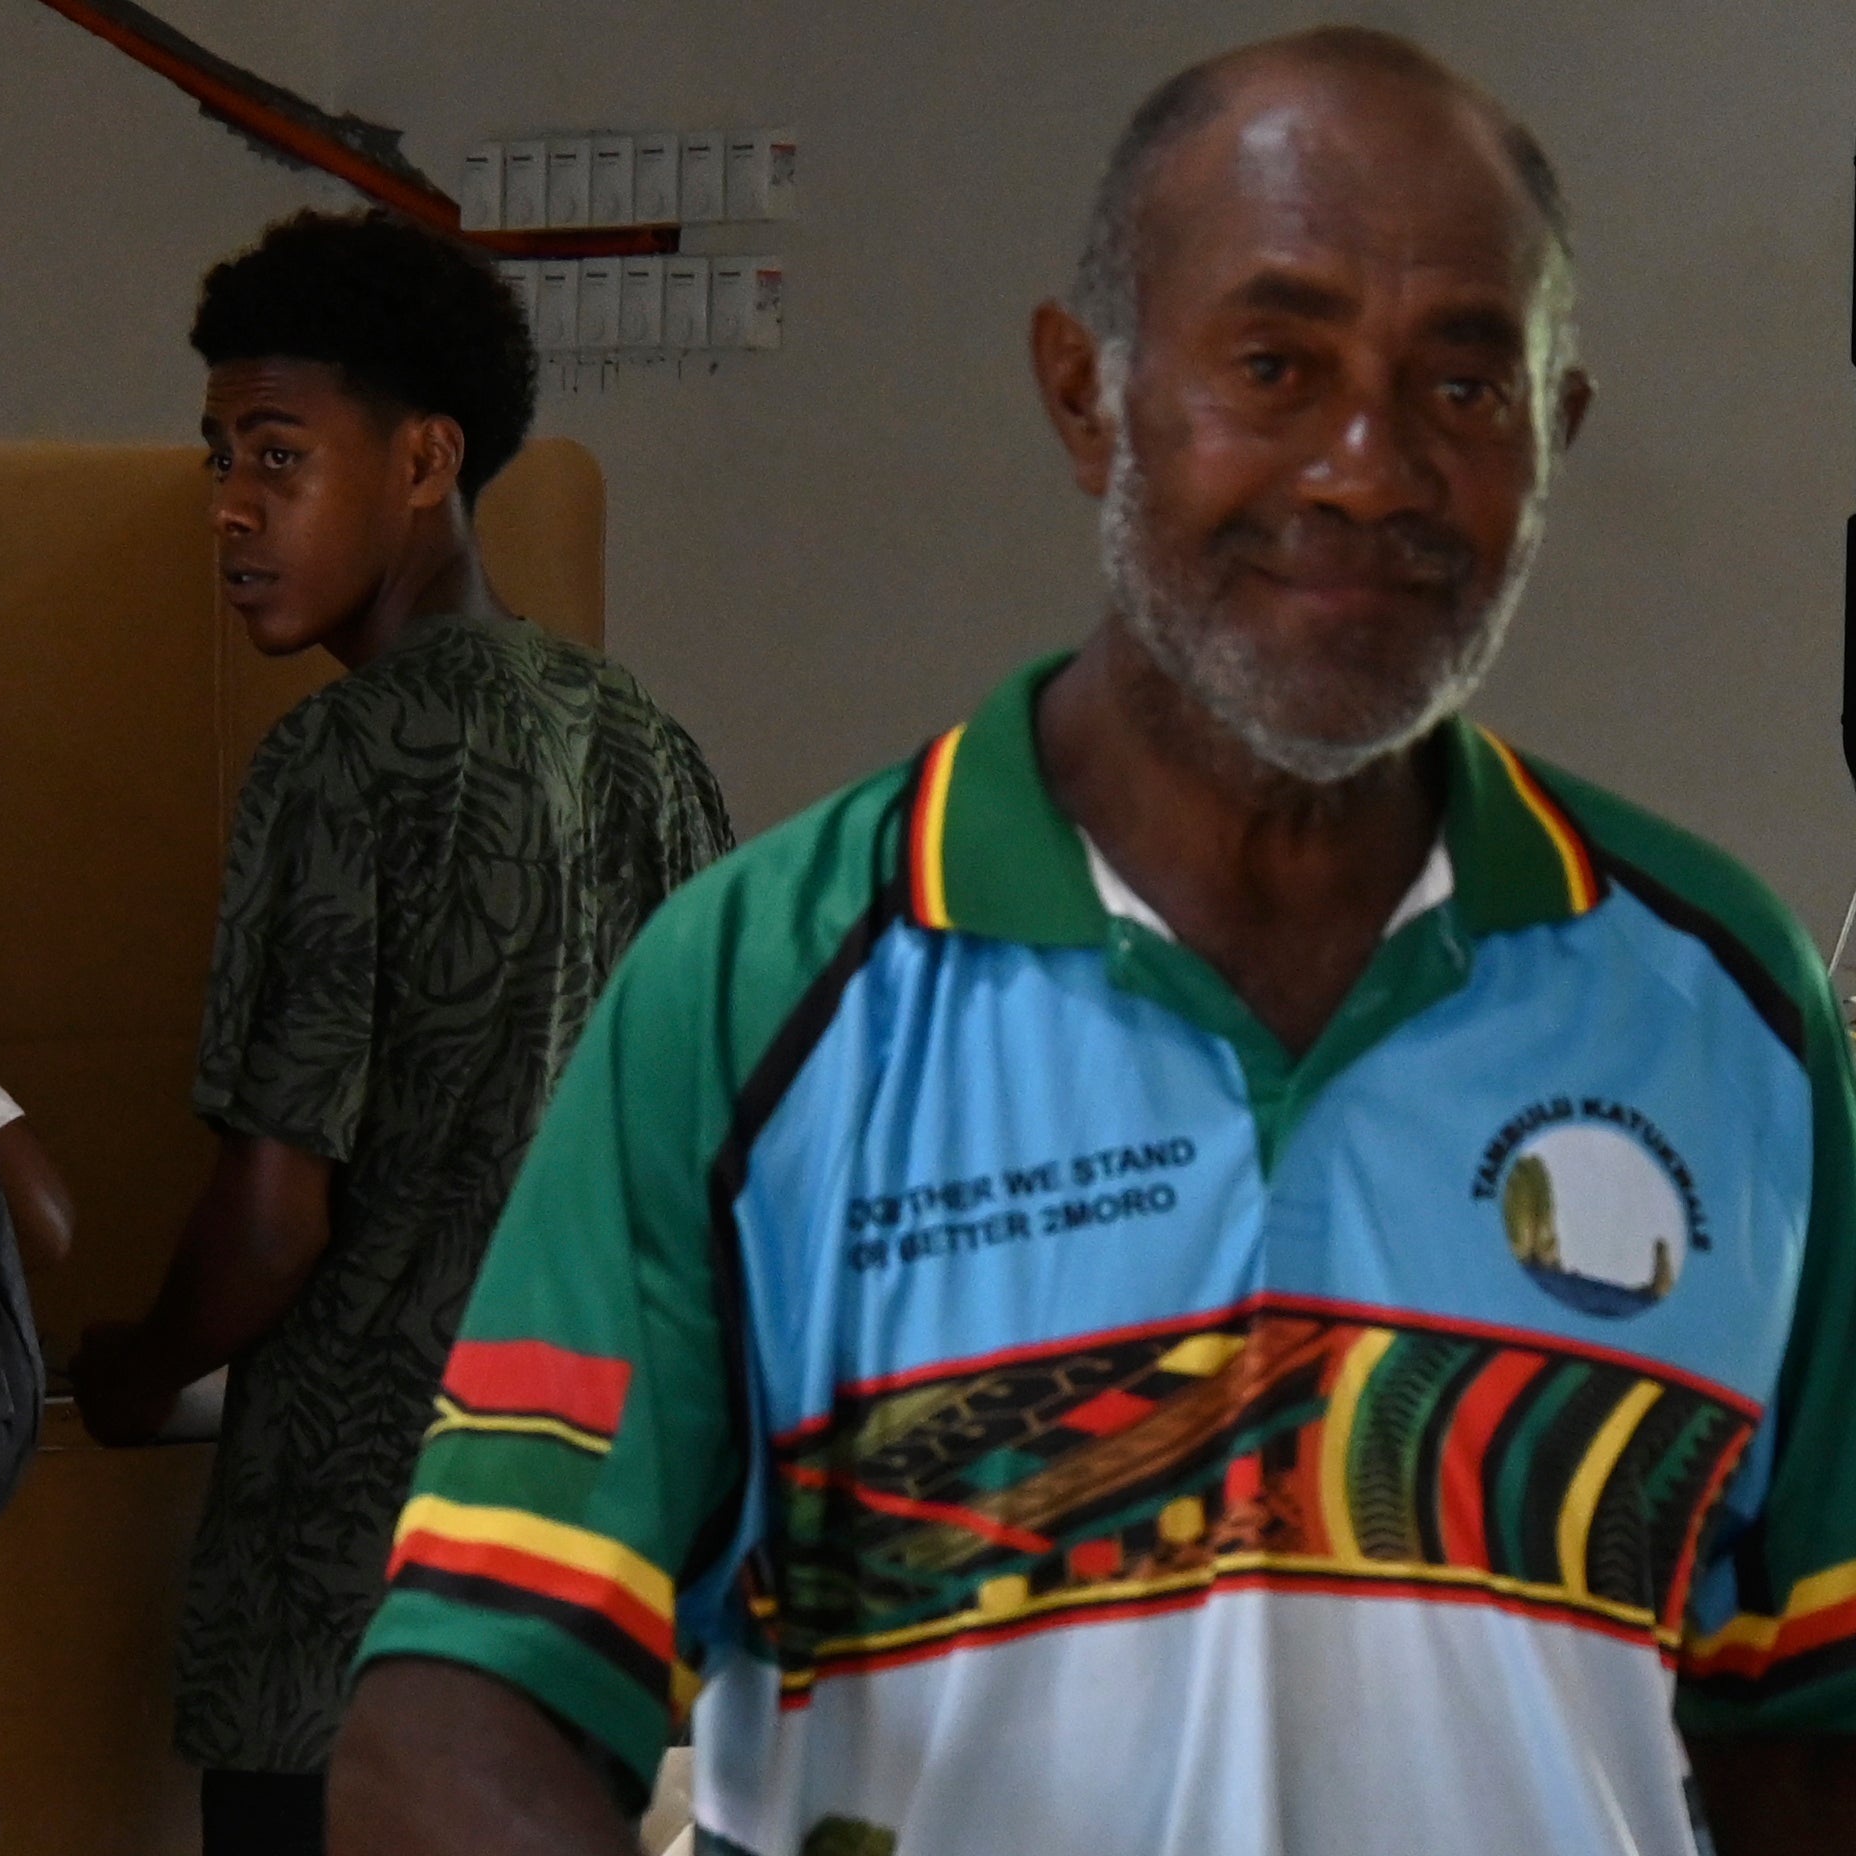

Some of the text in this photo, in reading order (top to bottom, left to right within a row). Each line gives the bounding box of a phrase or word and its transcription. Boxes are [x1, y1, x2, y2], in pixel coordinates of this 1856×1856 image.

[1001, 1160, 1059, 1198] WE
[1070, 1136, 1197, 1187] STAND
[899, 1210, 1032, 1265] BETTER
